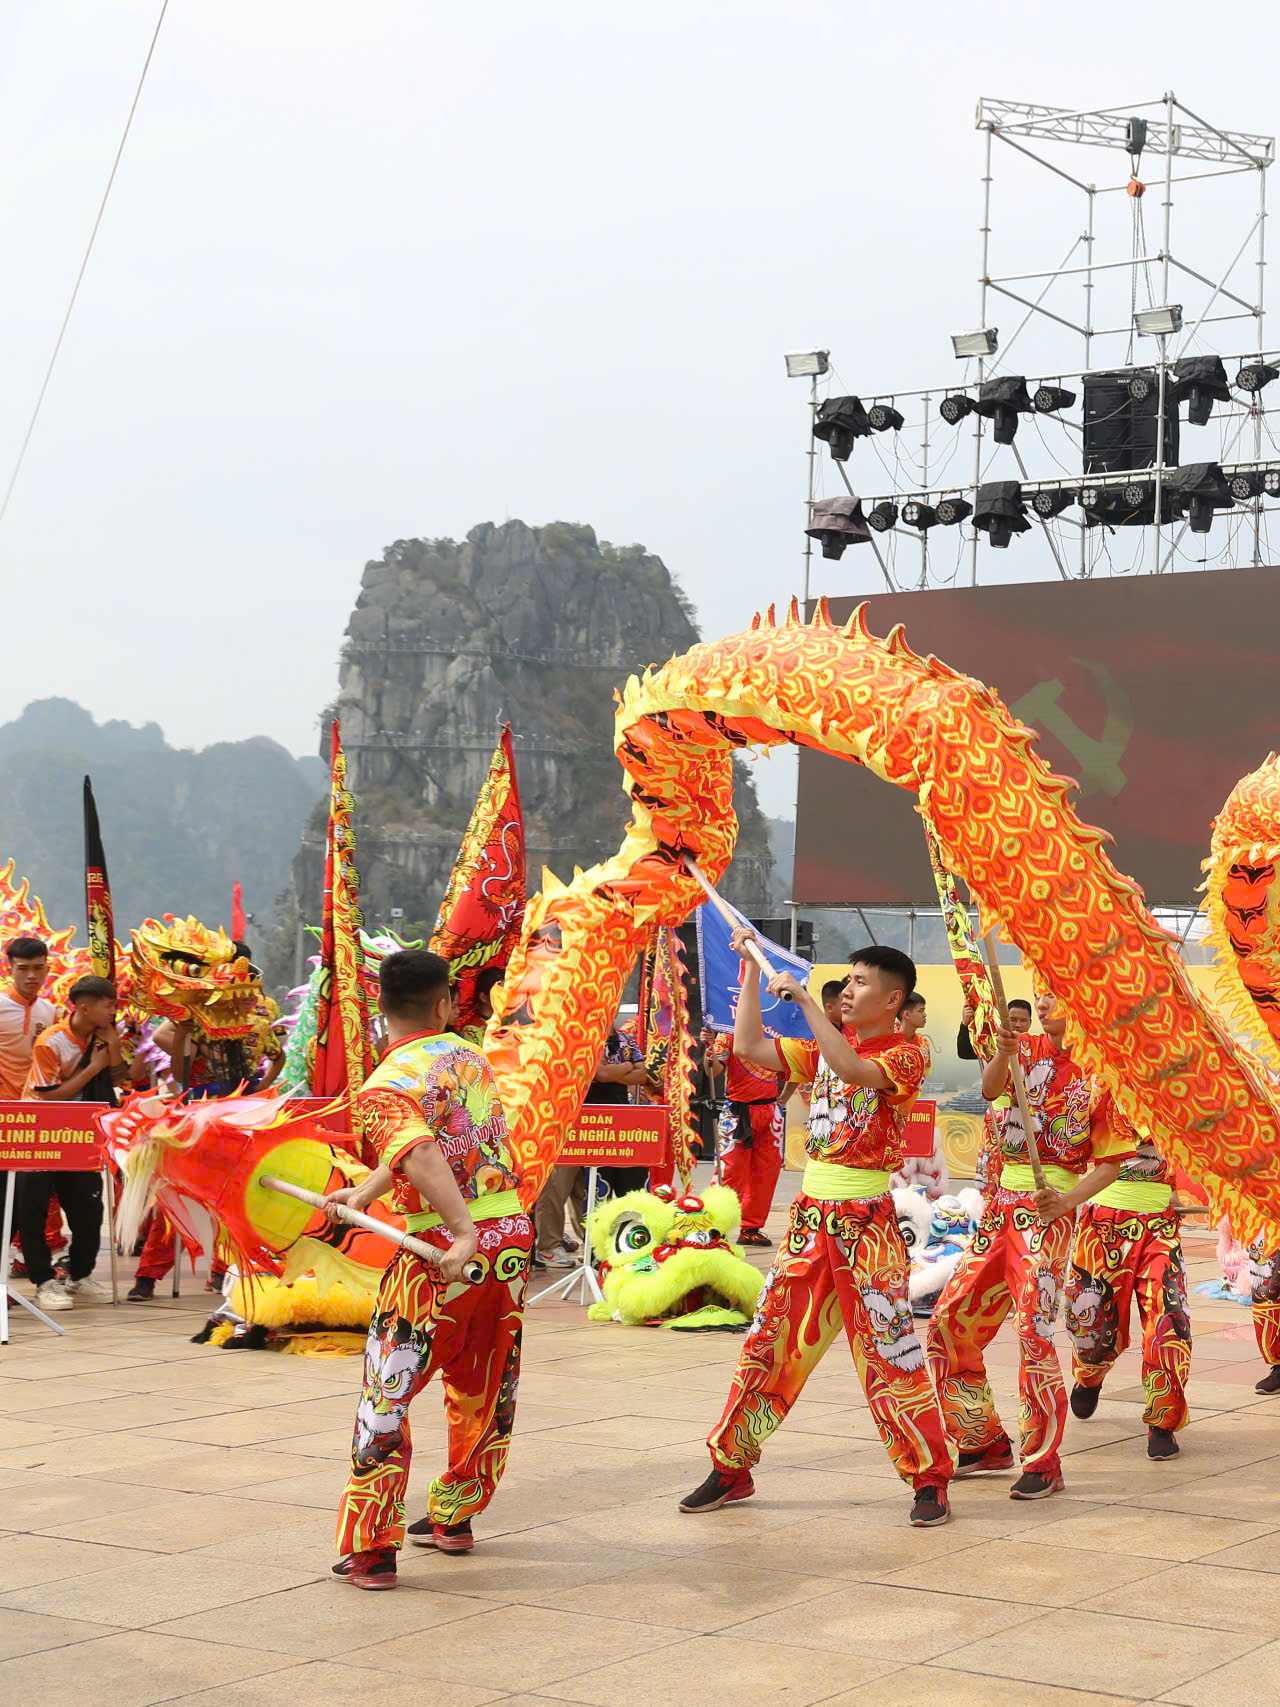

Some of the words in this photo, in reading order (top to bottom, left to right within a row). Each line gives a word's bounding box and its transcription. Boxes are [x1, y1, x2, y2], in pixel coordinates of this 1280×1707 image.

[581, 1114, 613, 1125] ĐOÀN
[39, 1127, 95, 1144] ĐƯỜNG
[579, 1127, 616, 1142] NGHĨA
[619, 1127, 659, 1143] ĐƯỜNG
[437, 1132, 468, 1159] hong
[562, 1146, 586, 1156] HÀNH
[0, 1148, 32, 1160] UẢNG
[34, 1150, 61, 1160] NINH
